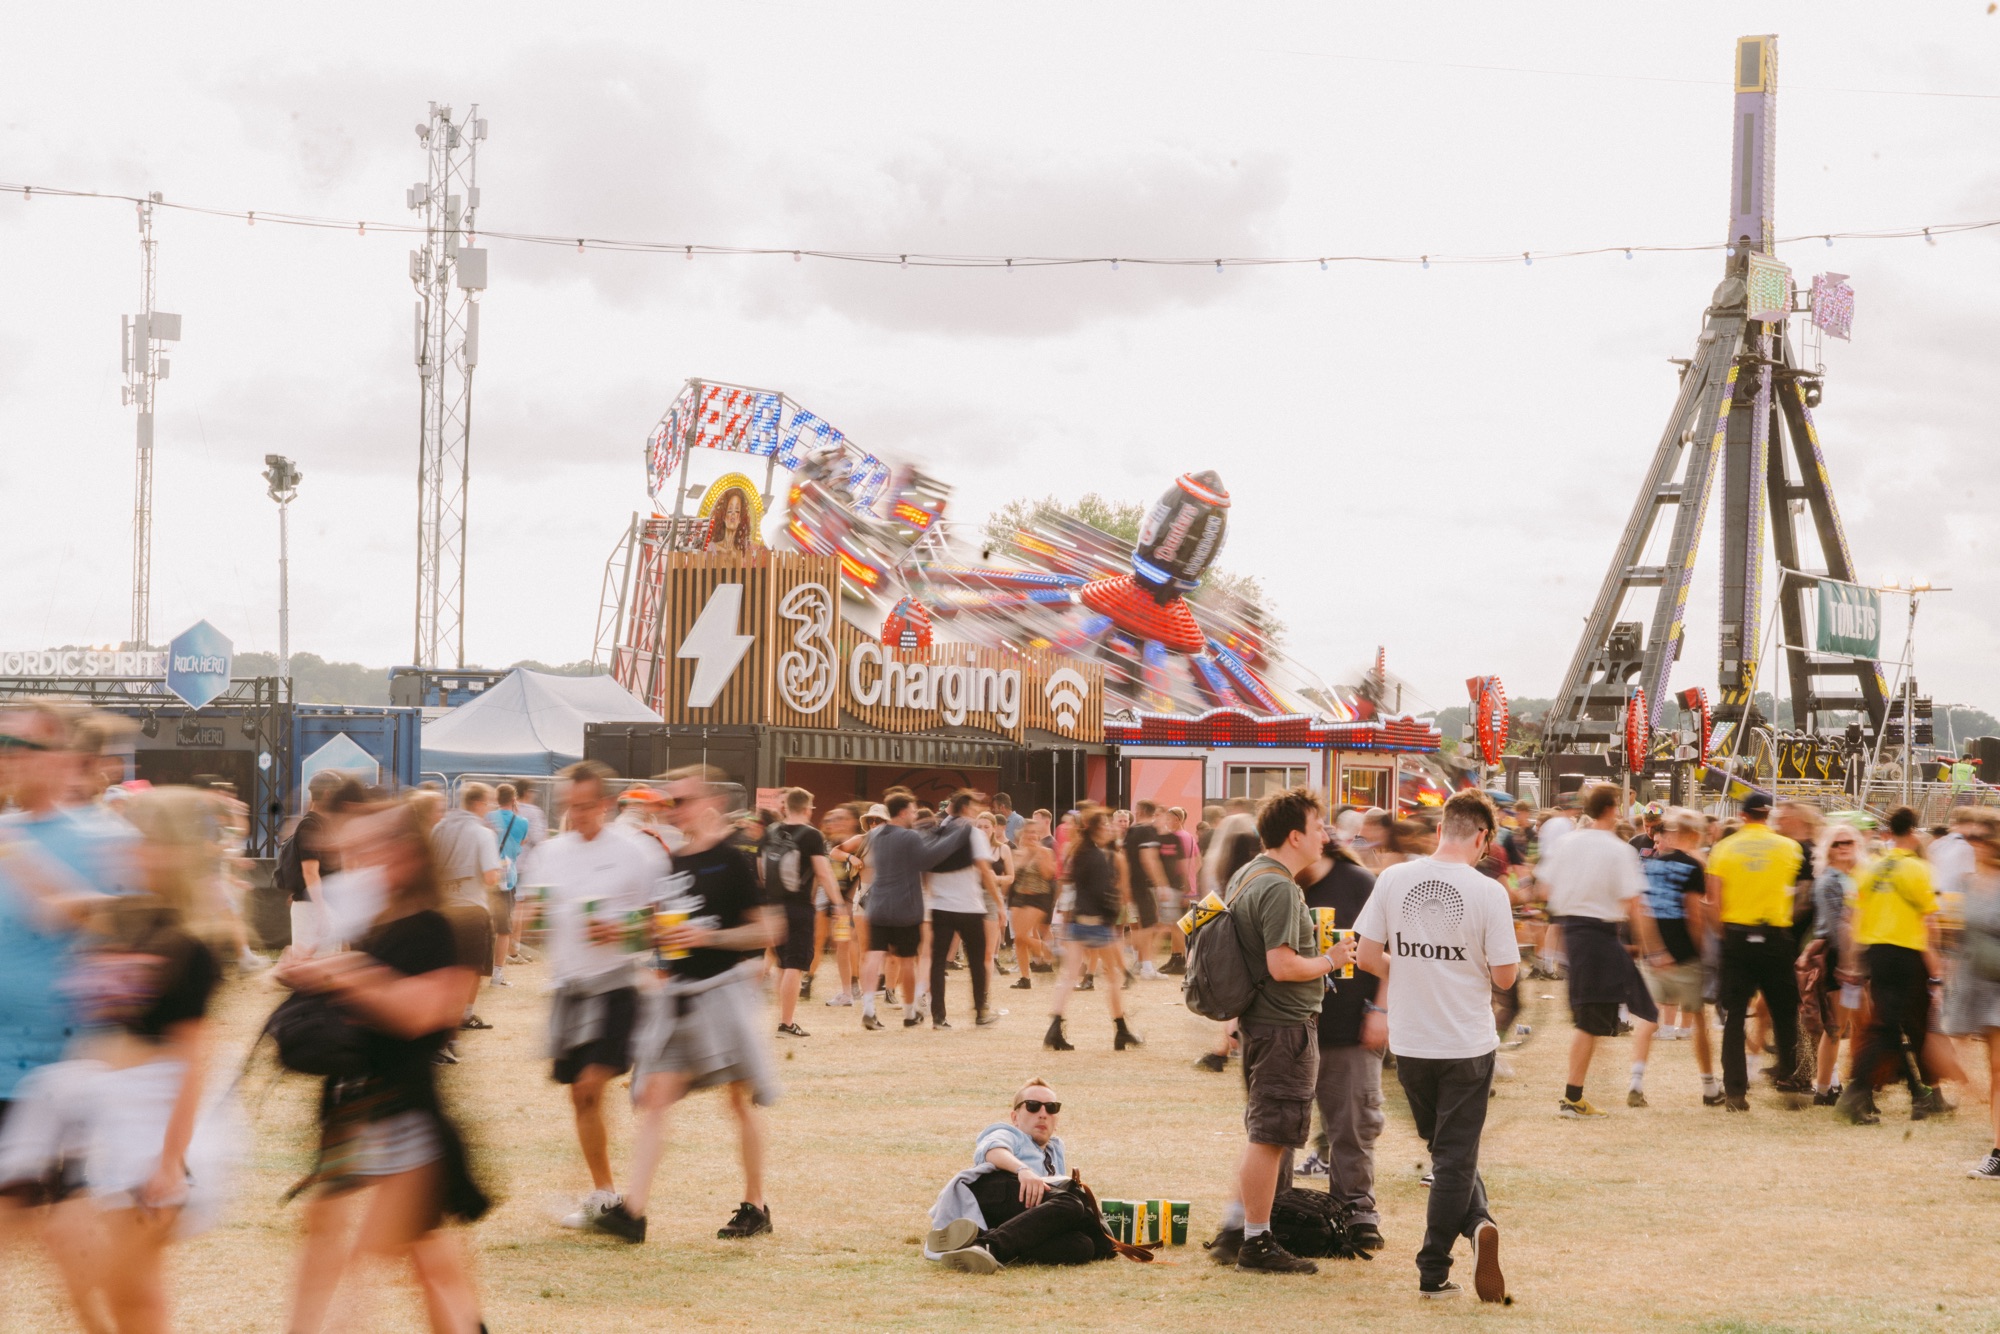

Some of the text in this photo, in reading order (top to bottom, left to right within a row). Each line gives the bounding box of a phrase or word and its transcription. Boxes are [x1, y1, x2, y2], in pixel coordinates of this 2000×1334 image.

[1830, 600, 1876, 641] TOILETS
[0, 651, 164, 676] ORDIC SPIRIT
[174, 652, 225, 675] ROCK HERO
[849, 642, 1021, 729] Charging
[201, 728, 223, 745] HERO
[1396, 932, 1468, 961] bronx
